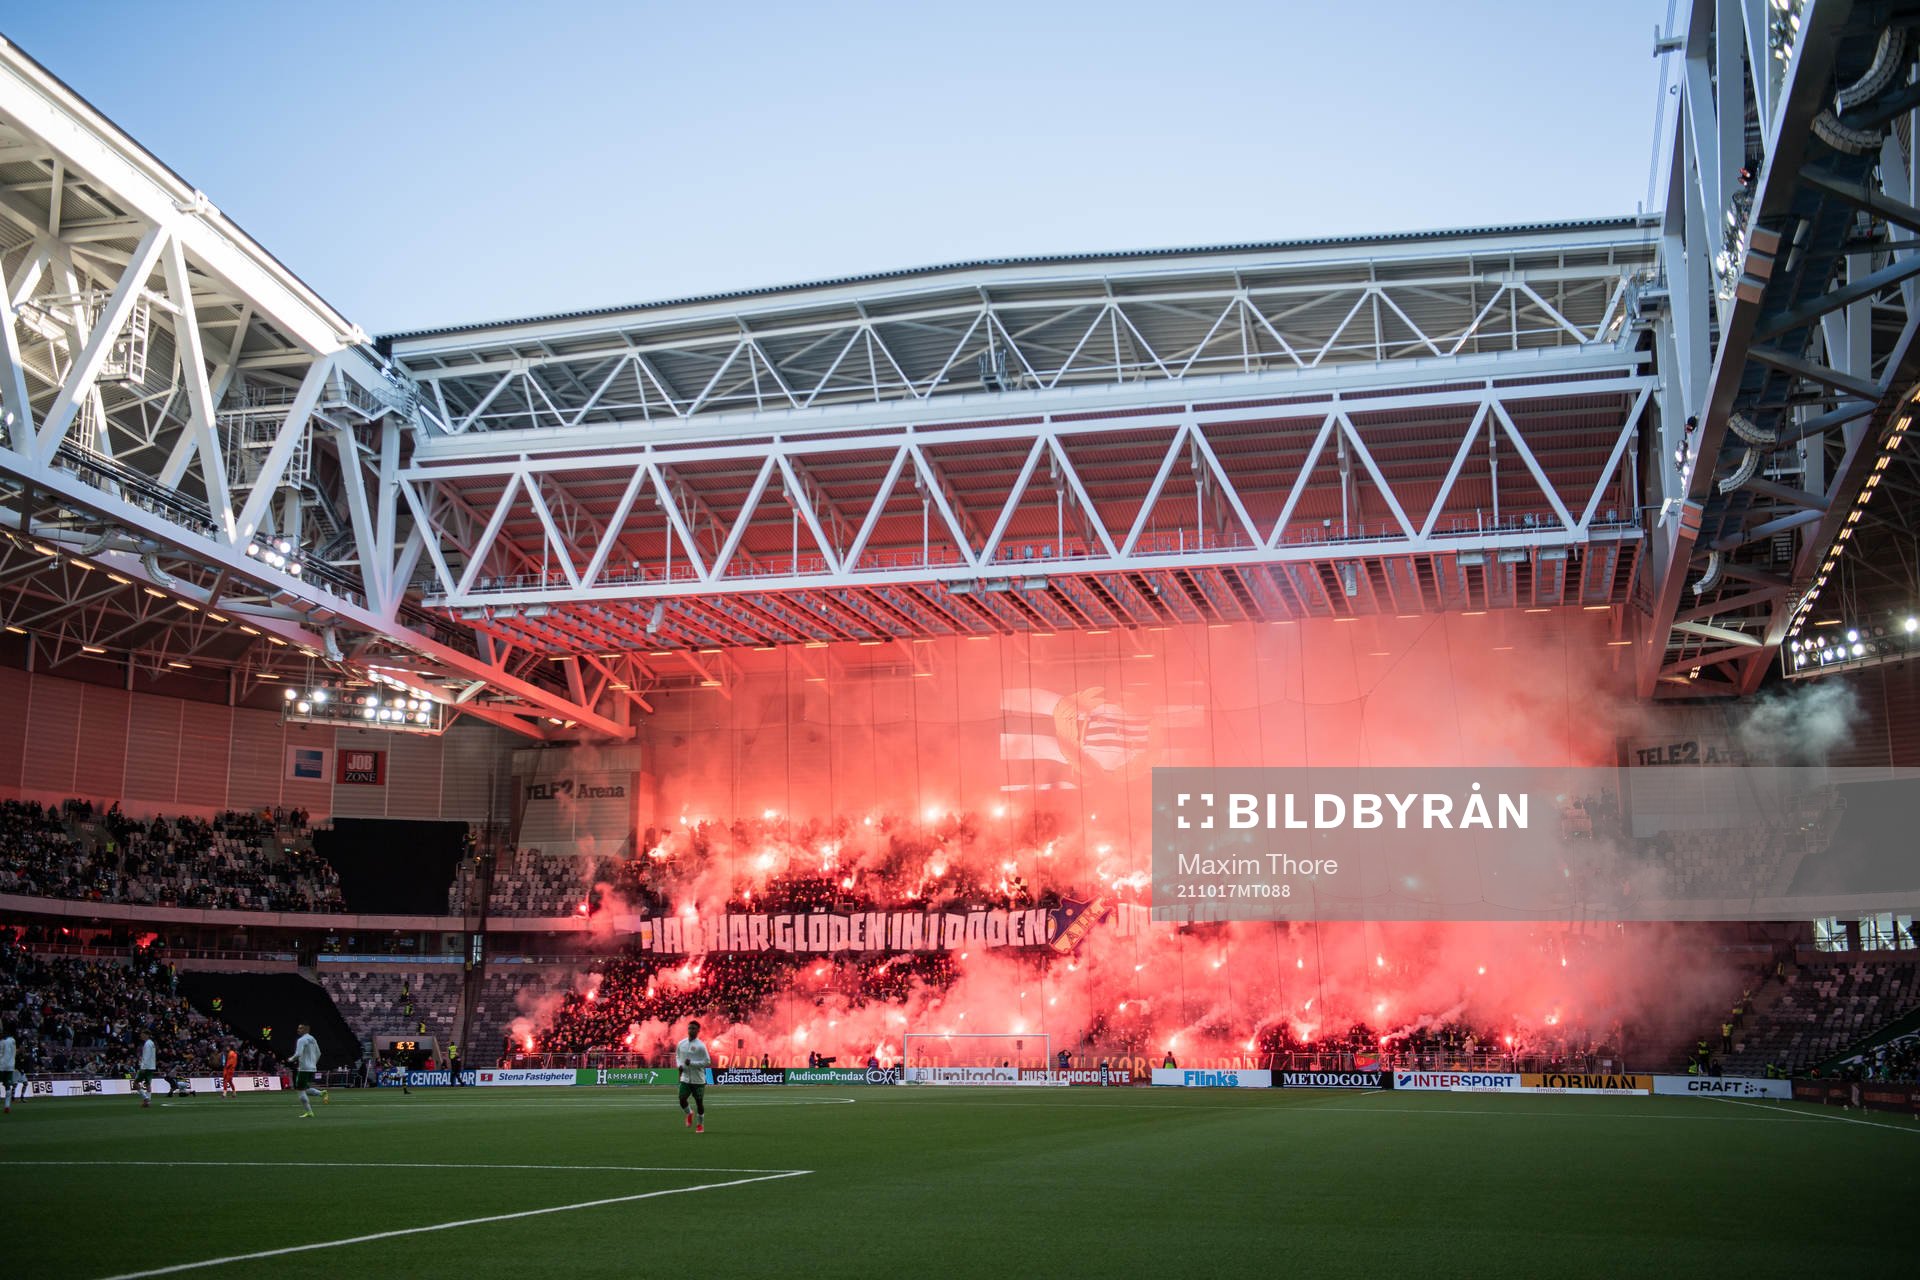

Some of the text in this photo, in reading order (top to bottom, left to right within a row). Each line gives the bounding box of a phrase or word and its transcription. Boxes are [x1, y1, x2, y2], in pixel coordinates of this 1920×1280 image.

[1637, 741, 1700, 765] TELE2
[348, 754, 373, 770] JOB
[345, 772, 377, 782] ZONE
[577, 784, 624, 799] Arena
[410, 1072, 452, 1085] CENTRAL
[498, 1072, 574, 1082] Stena Fastigheter
[716, 1072, 784, 1085] glasmästeri
[788, 1071, 865, 1081] AudicomPendax
[932, 1068, 1007, 1080] limitado
[1183, 1071, 1238, 1086] Flinks
[1283, 1072, 1382, 1086] METODGOLV
[1413, 1074, 1514, 1087] INTERSPORT
[32, 1081, 53, 1093] FSG
[253, 1078, 269, 1088] FSG
[1688, 1081, 1743, 1093] CRAFT
